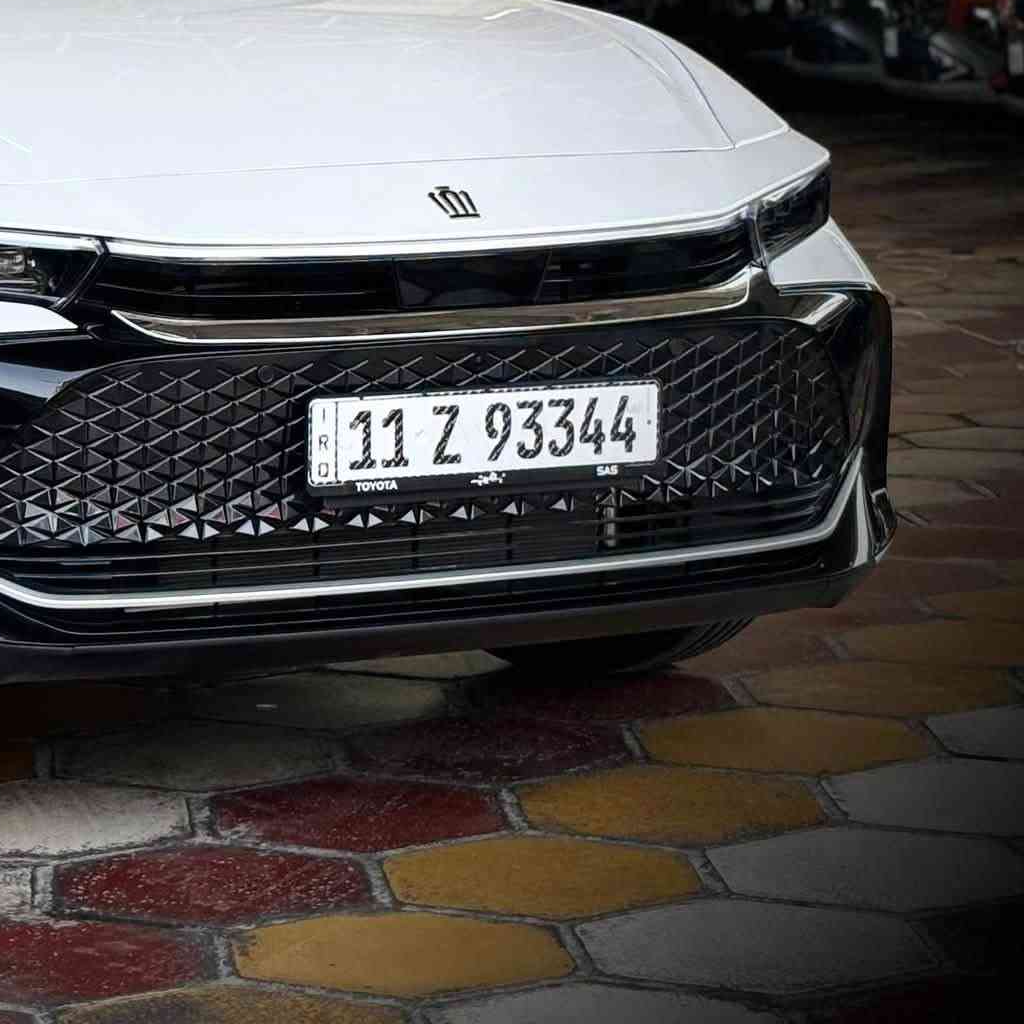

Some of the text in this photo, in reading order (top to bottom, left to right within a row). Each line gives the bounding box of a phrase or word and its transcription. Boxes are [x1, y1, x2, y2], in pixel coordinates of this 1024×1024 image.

[349, 395, 636, 470] 11 Z 93344
[596, 464, 619, 476] SAS
[355, 479, 398, 492] TOYOTA
